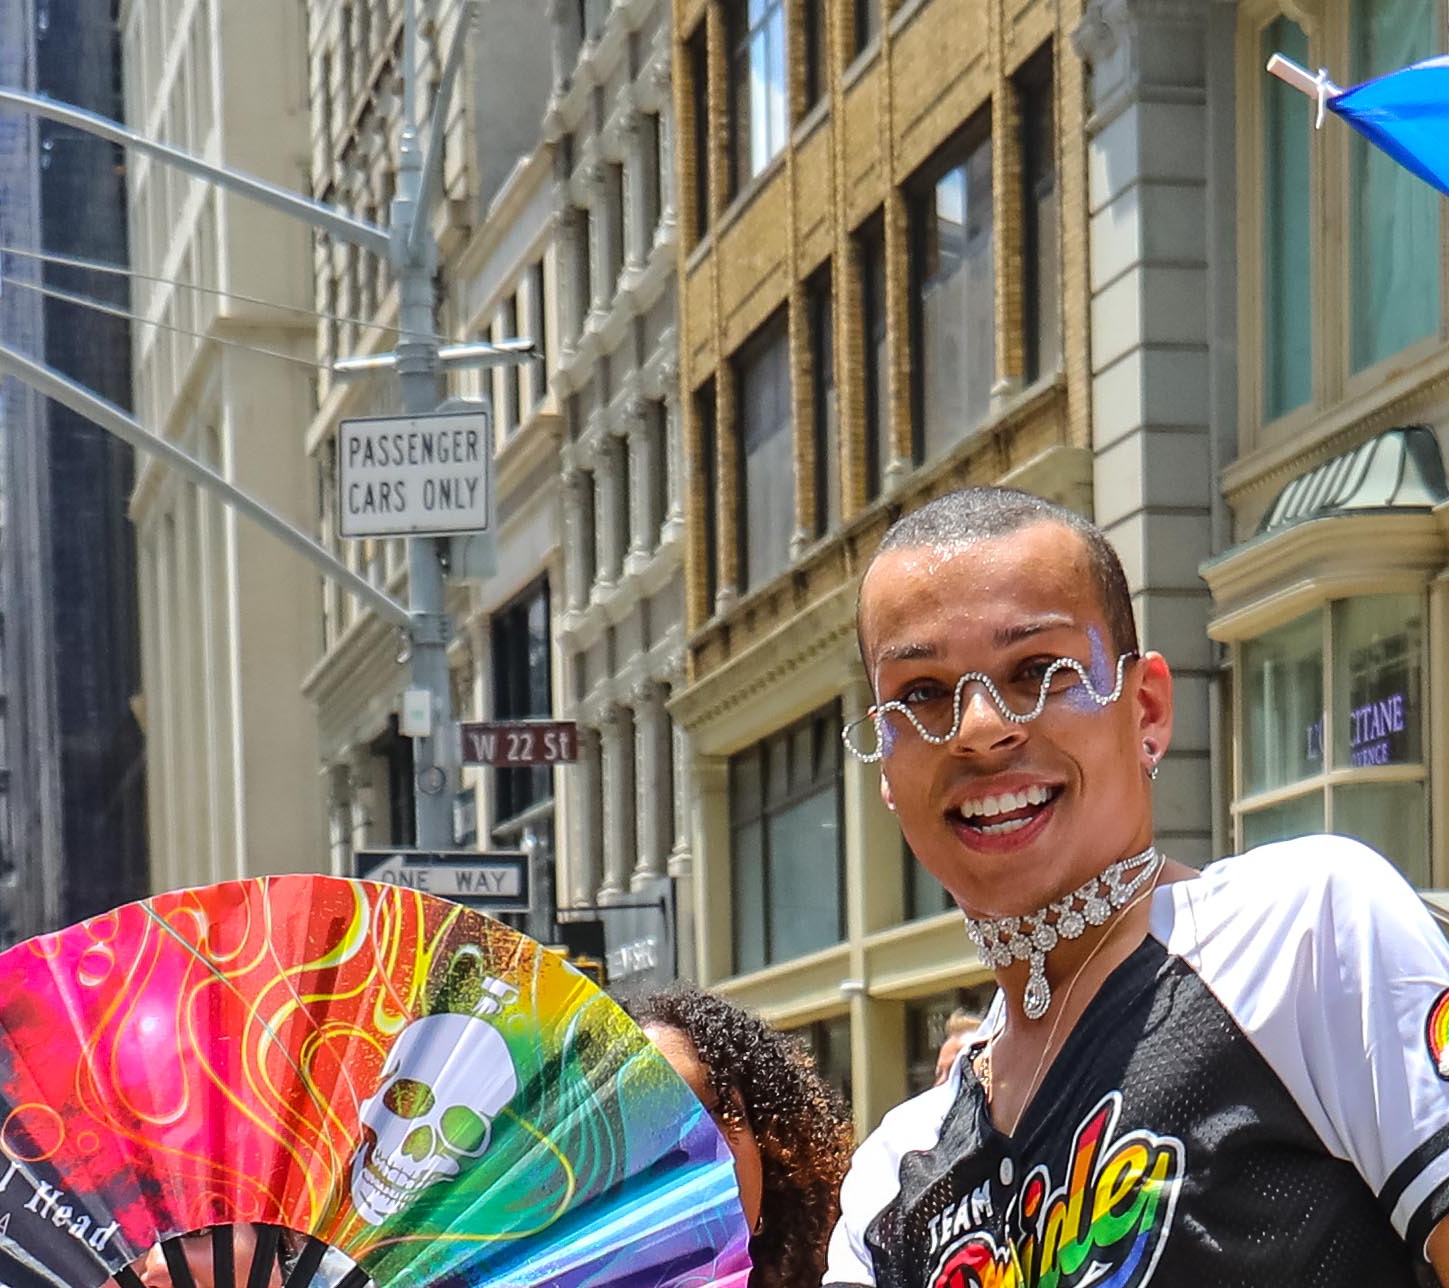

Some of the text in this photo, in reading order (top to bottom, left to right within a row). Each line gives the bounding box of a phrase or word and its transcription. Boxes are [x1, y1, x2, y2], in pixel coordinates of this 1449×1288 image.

[348, 430, 480, 469] PASSENGER
[348, 477, 479, 514] CARS ONLY
[469, 733, 570, 762] W 22 St
[381, 868, 509, 893] ONE WAY
[23, 1180, 121, 1252] Head
[926, 1179, 995, 1254] TEAM
